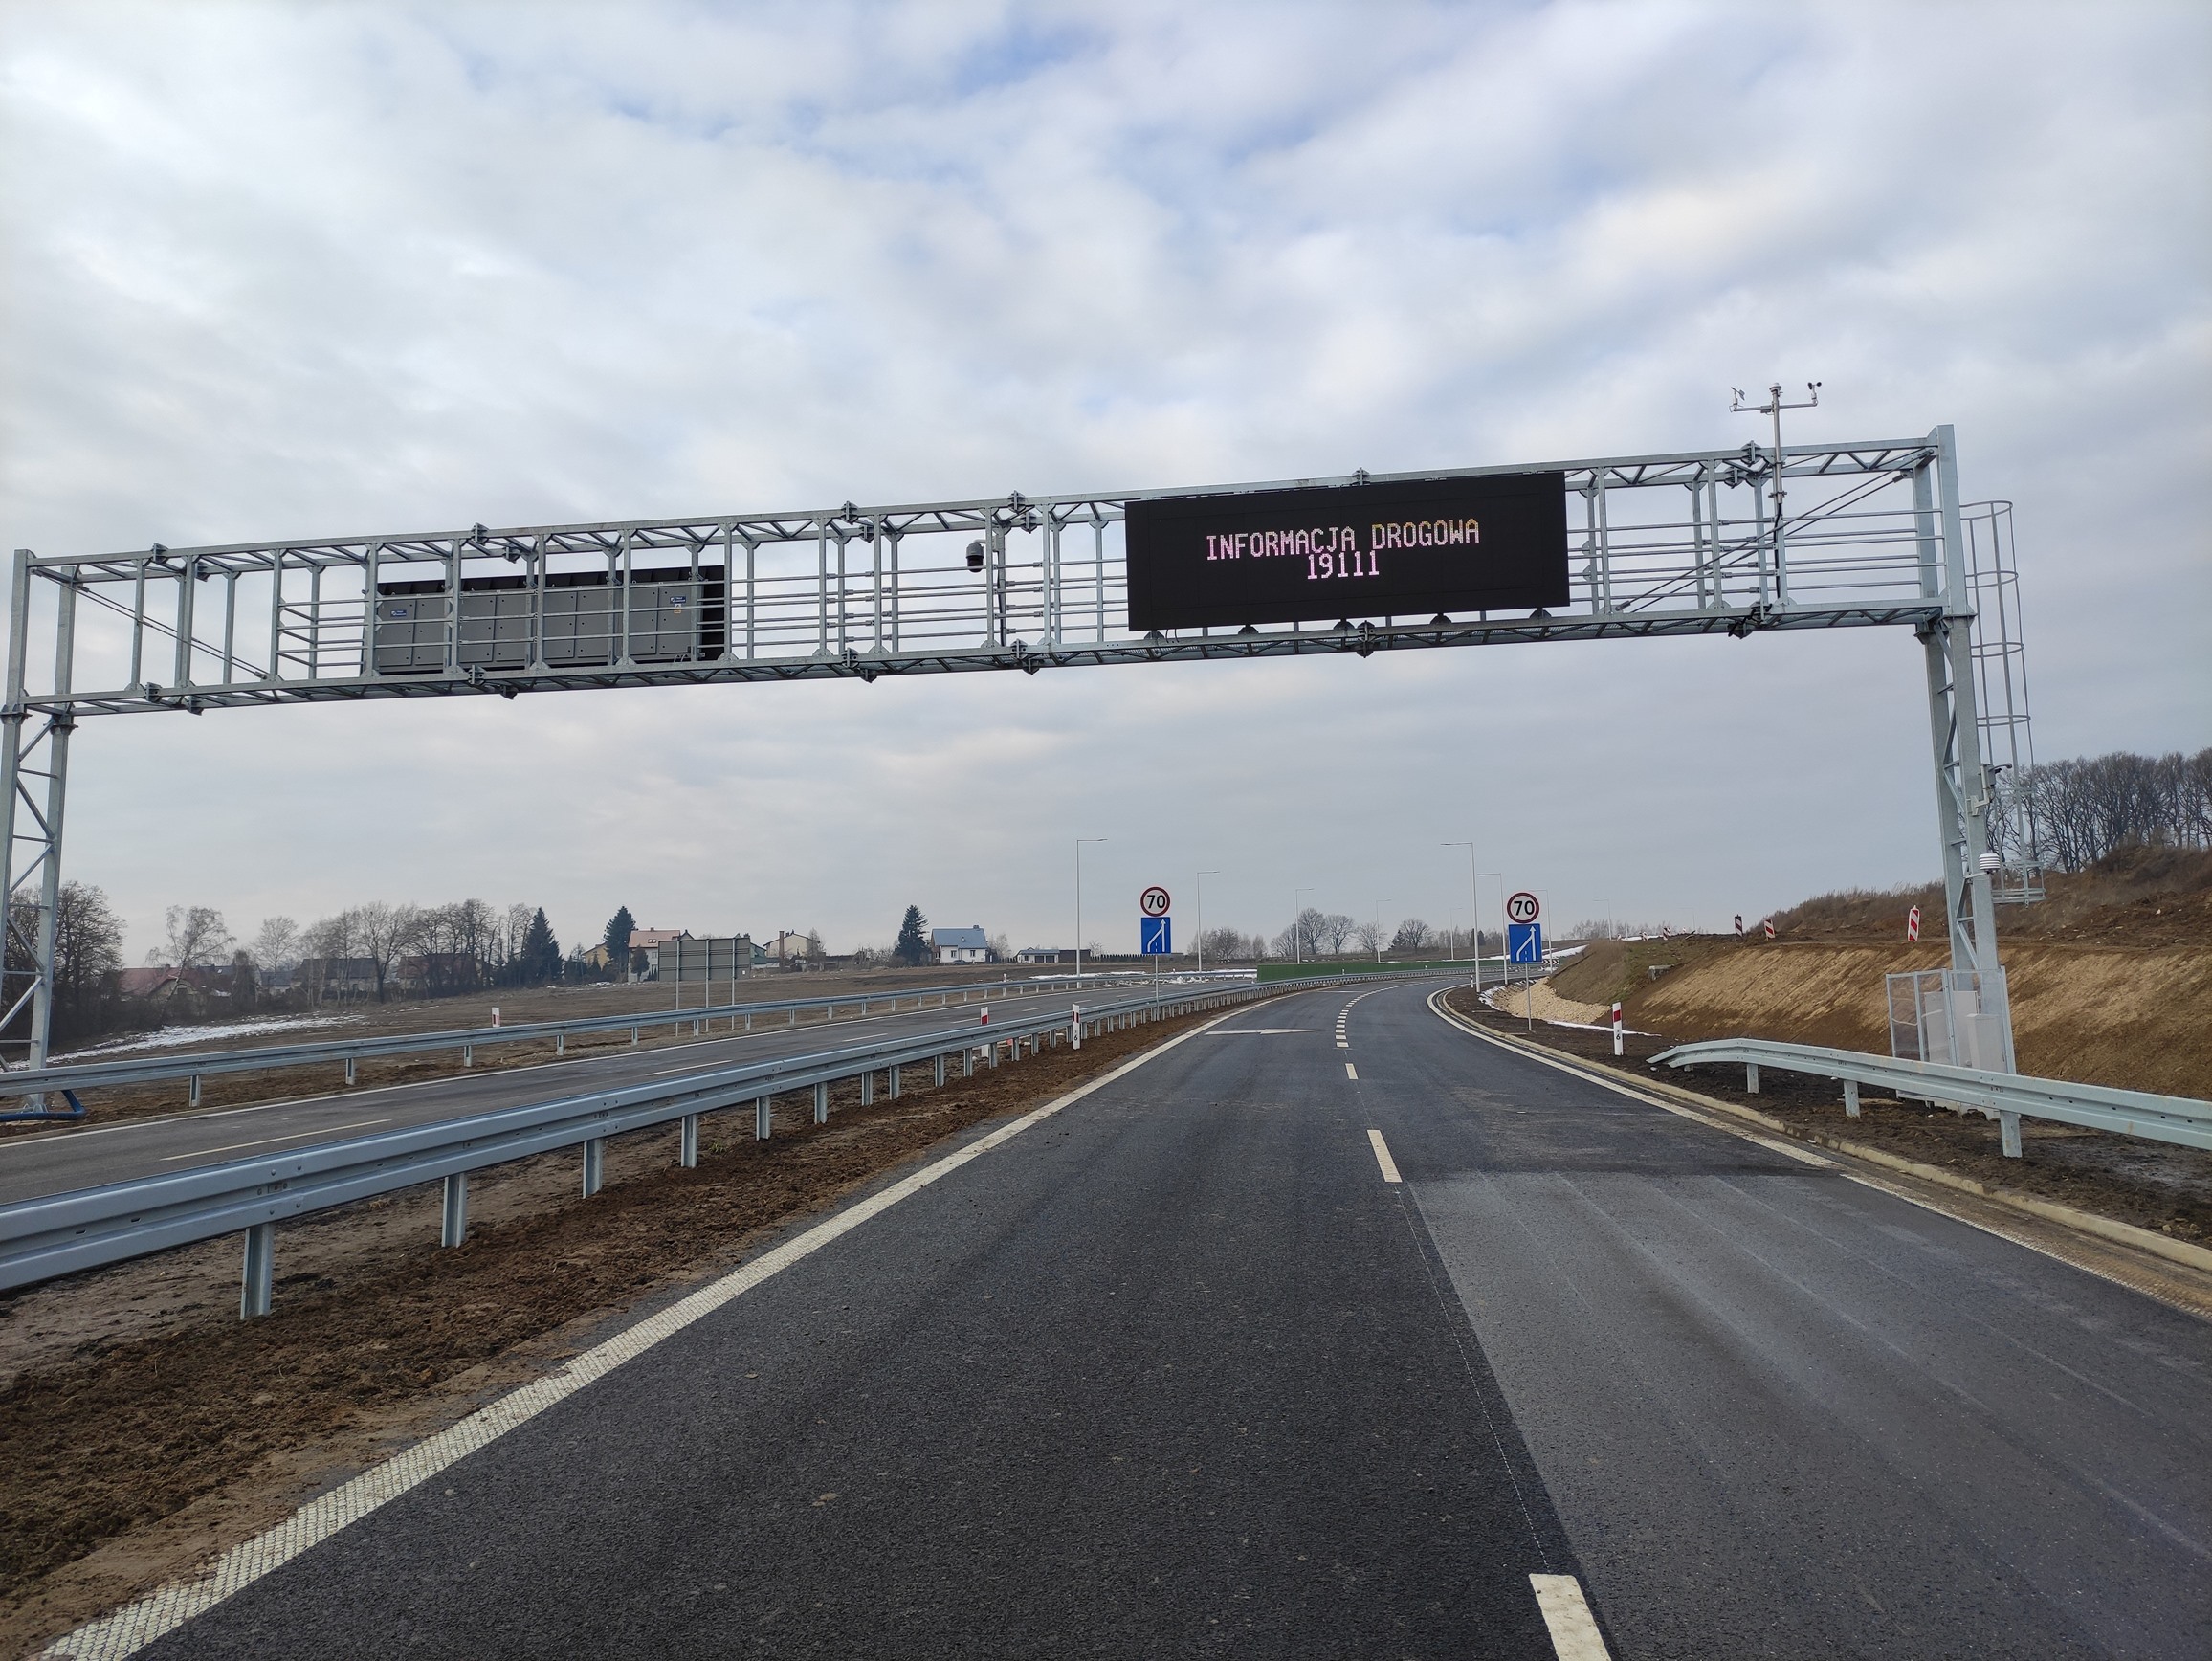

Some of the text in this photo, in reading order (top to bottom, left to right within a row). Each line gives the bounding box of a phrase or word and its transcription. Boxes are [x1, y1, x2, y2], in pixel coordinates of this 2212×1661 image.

[1206, 518, 1480, 561] INFORMACJA DROGOWA
[1307, 550, 1380, 580] 19111
[1146, 895, 1166, 909] 70
[1514, 900, 1535, 916] 70
